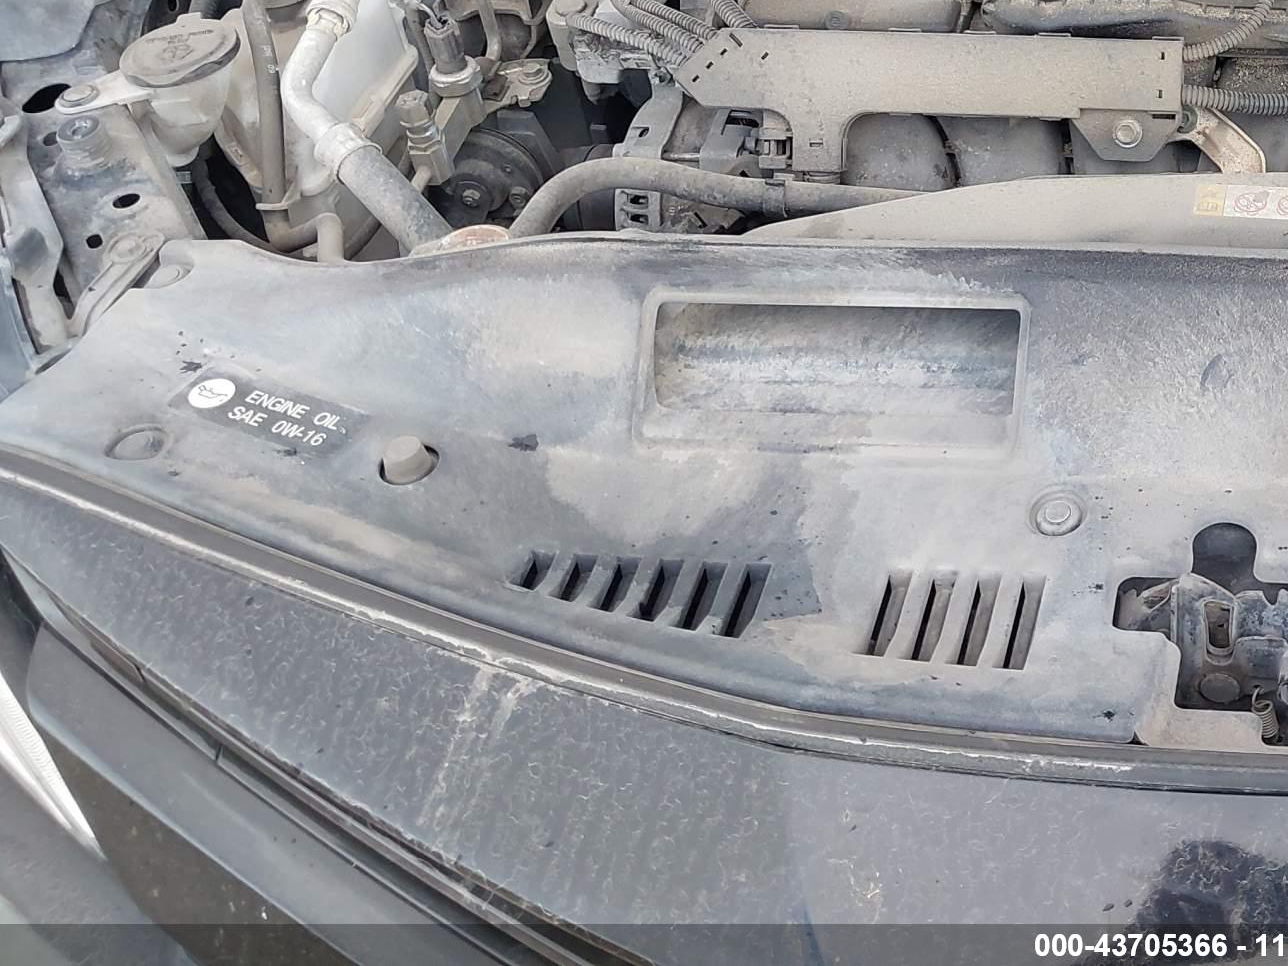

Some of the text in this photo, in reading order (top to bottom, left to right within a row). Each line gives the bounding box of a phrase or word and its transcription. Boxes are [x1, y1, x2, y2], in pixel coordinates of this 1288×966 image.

[228, 406, 326, 446] SAE 0W-16
[245, 390, 340, 430] ENGINE OIL
